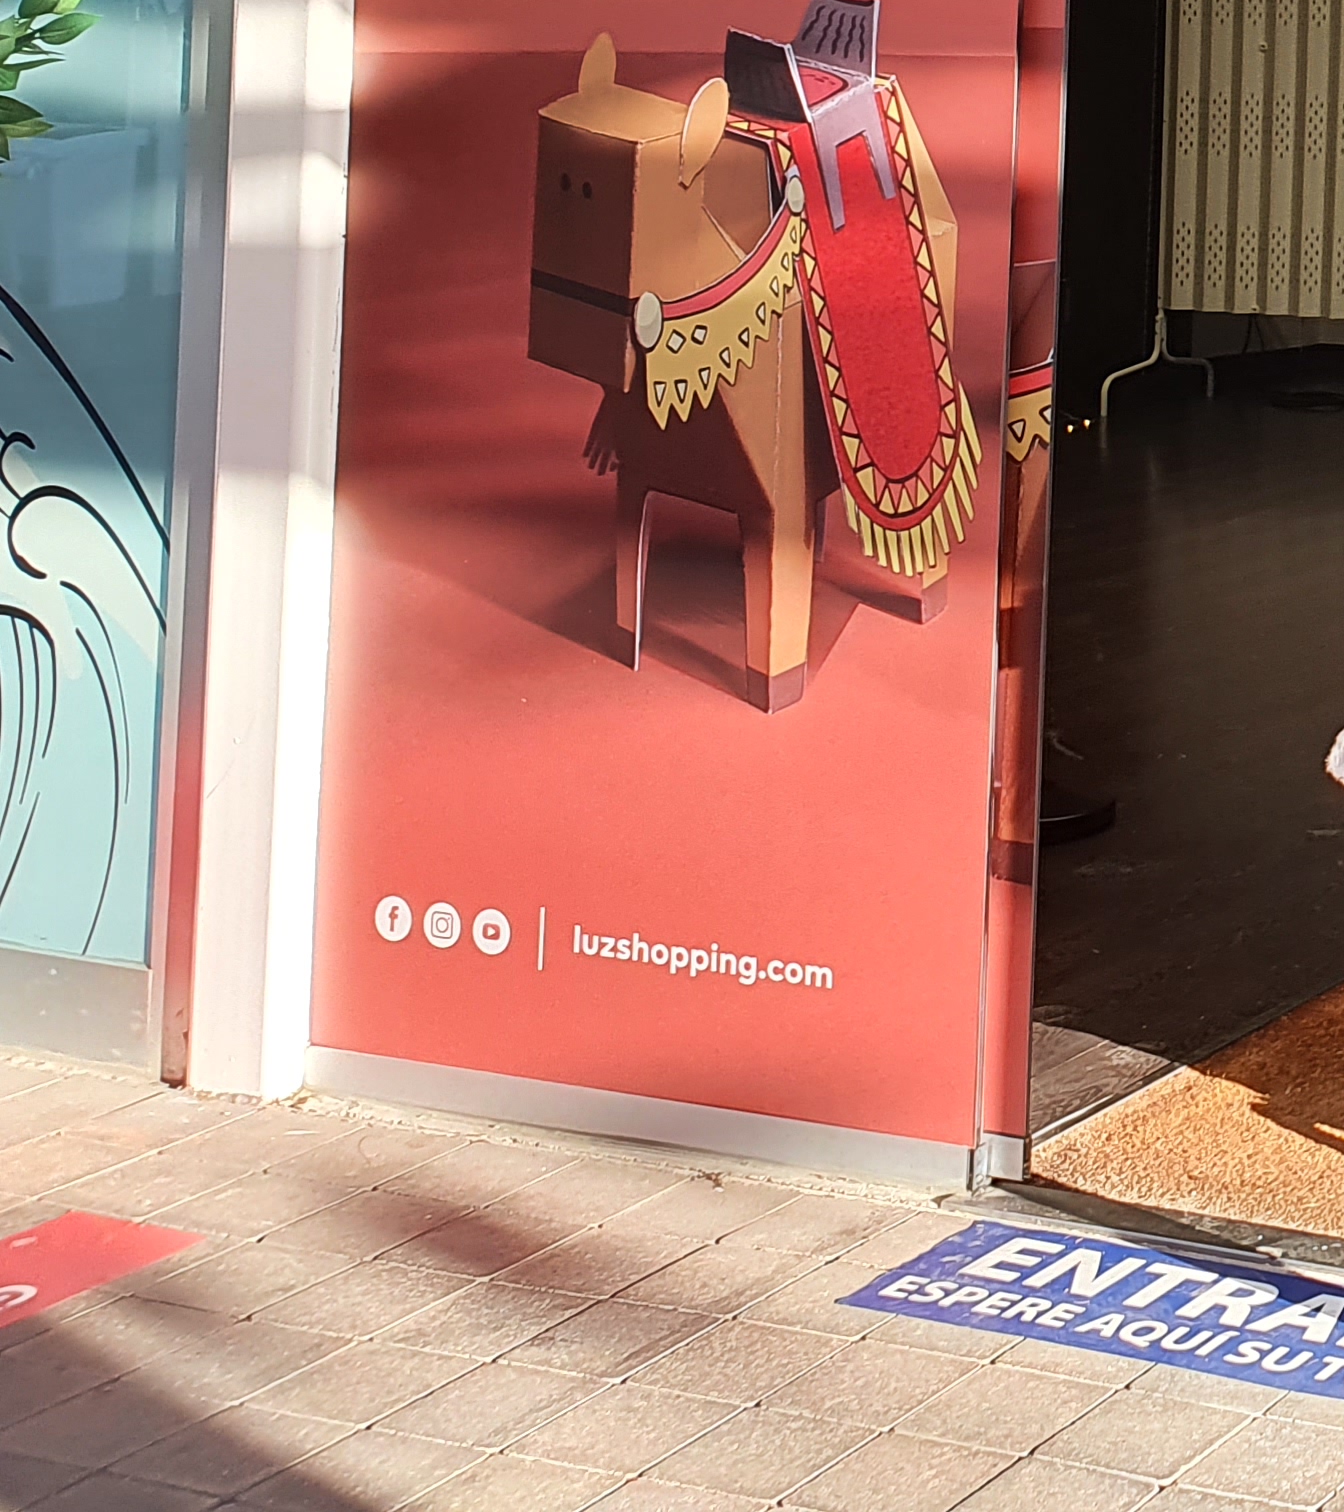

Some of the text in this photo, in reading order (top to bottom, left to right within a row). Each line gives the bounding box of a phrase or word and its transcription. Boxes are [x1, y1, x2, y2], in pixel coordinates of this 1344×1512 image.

[573, 924, 834, 990] luzshopping.com
[879, 1274, 1088, 1329] ESPERE
[1223, 1338, 1319, 1374] SU
